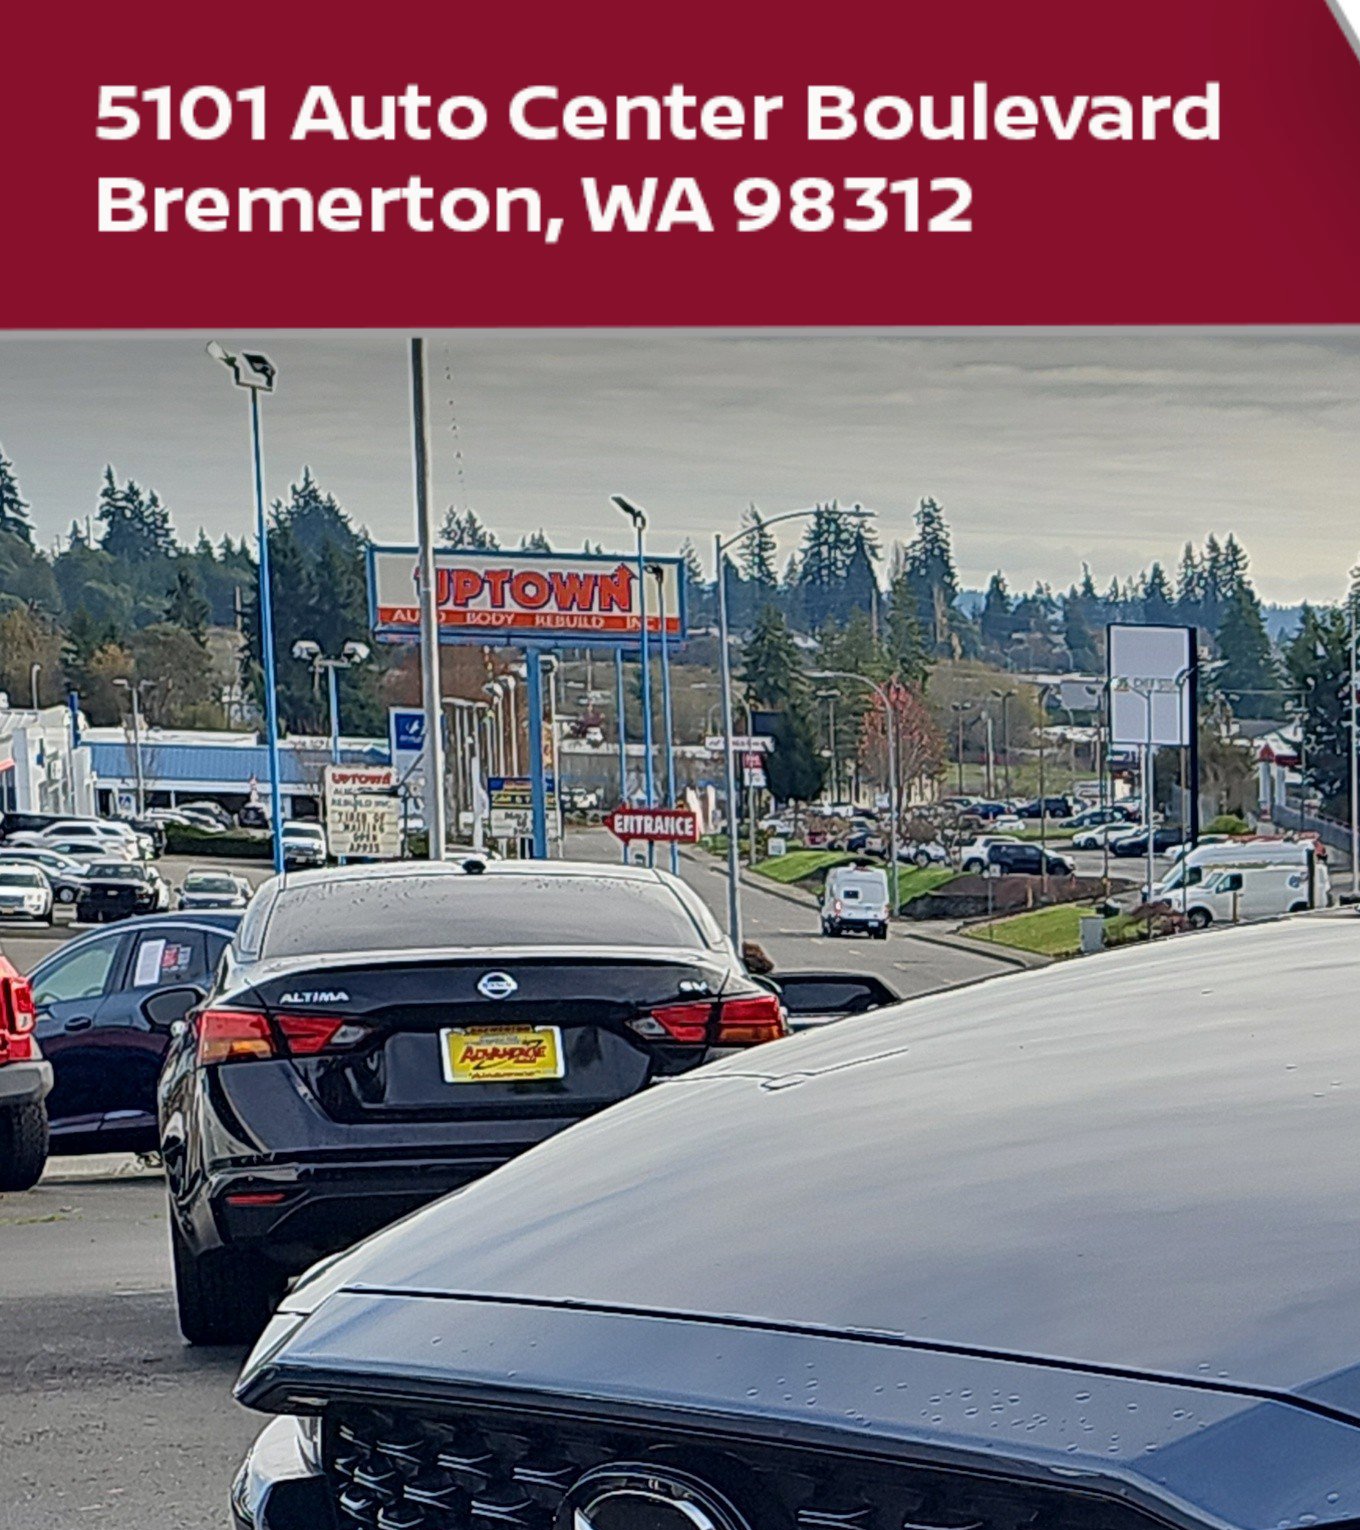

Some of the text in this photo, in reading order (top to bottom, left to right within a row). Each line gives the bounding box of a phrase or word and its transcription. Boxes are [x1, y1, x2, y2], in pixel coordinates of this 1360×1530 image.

[465, 612, 516, 627] BODY
[534, 614, 605, 630] REBUILD
[331, 771, 392, 785] UPTOWN
[613, 813, 695, 836] ENTRANCE
[279, 990, 350, 1004] ALTIMA
